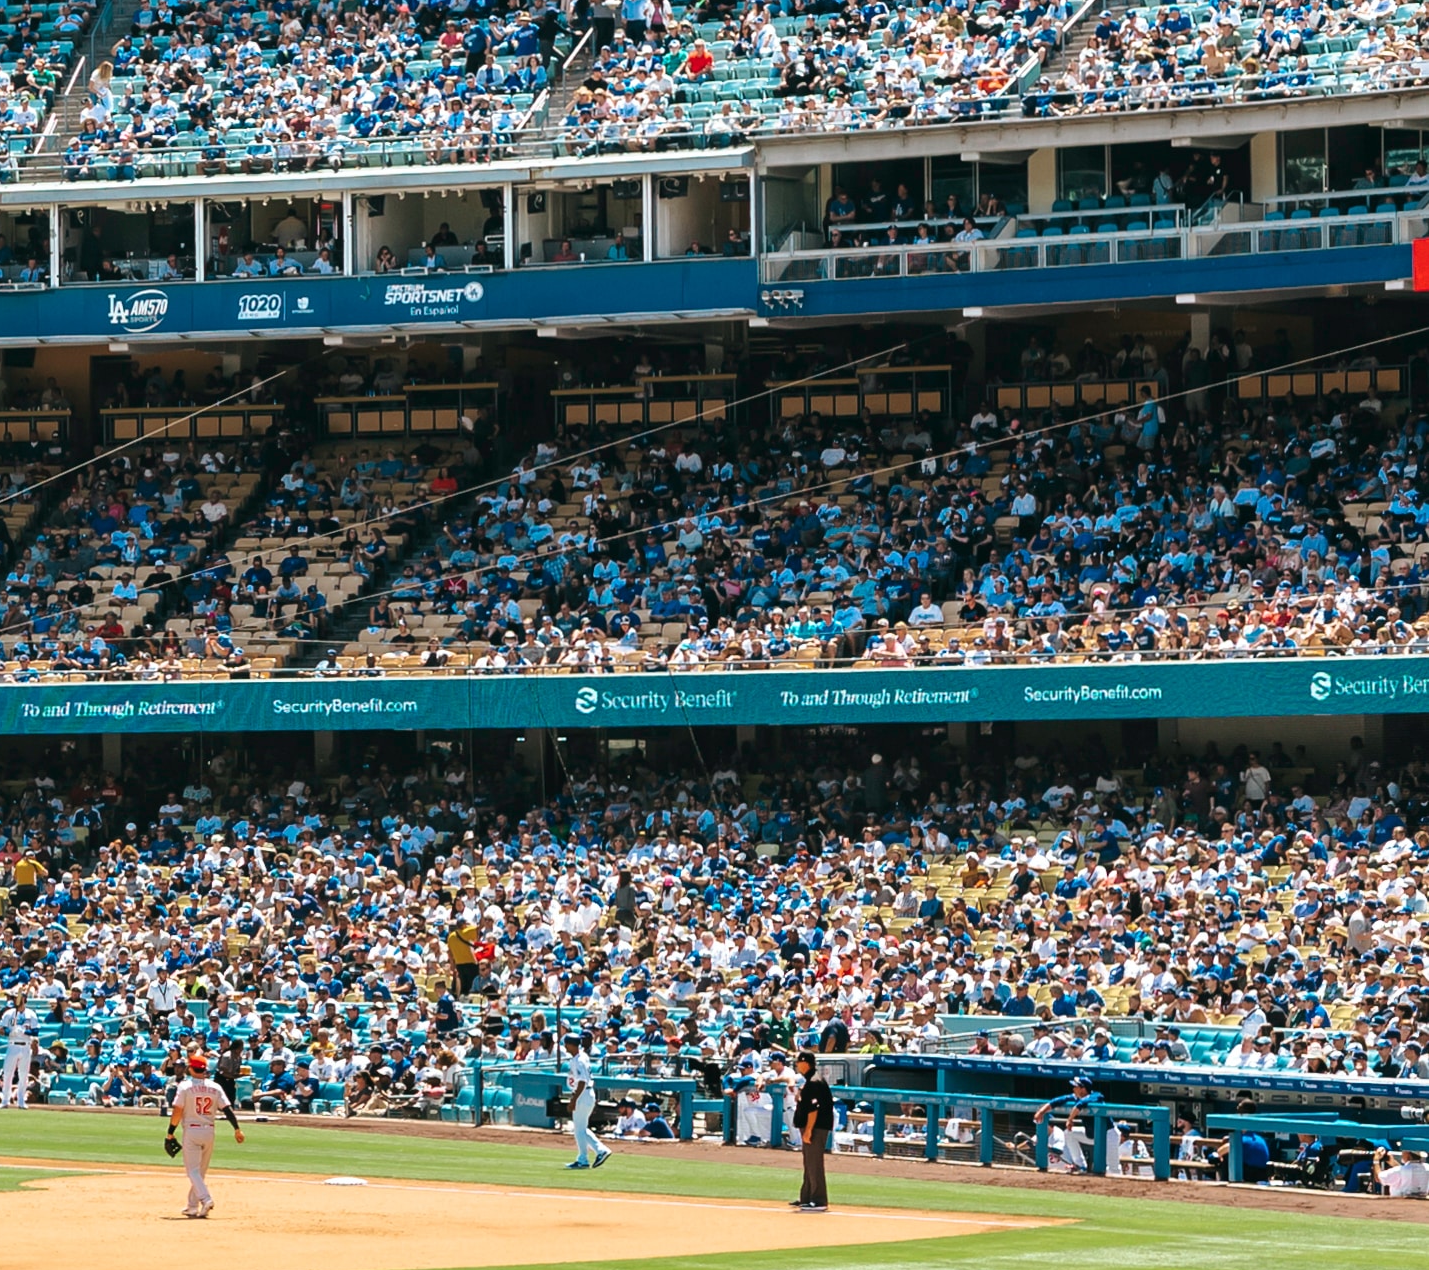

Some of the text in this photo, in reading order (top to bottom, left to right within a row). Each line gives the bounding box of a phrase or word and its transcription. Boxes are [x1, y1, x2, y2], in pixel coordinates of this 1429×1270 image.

[239, 295, 281, 312] 1020
[384, 288, 464, 305] SPORTSNET
[130, 298, 168, 316] AM570
[410, 305, 459, 317] En Español
[1024, 685, 1162, 704] SecurityBenefit.com
[1335, 676, 1399, 699] Security
[273, 698, 417, 716] SecurityBenefit.com
[602, 690, 670, 713] Security
[780, 691, 798, 706] To
[802, 690, 829, 706] and
[832, 689, 891, 709] Through
[22, 703, 39, 718] To
[42, 702, 70, 717] and
[74, 701, 135, 719] Through
[195, 1096, 213, 1115] 52
